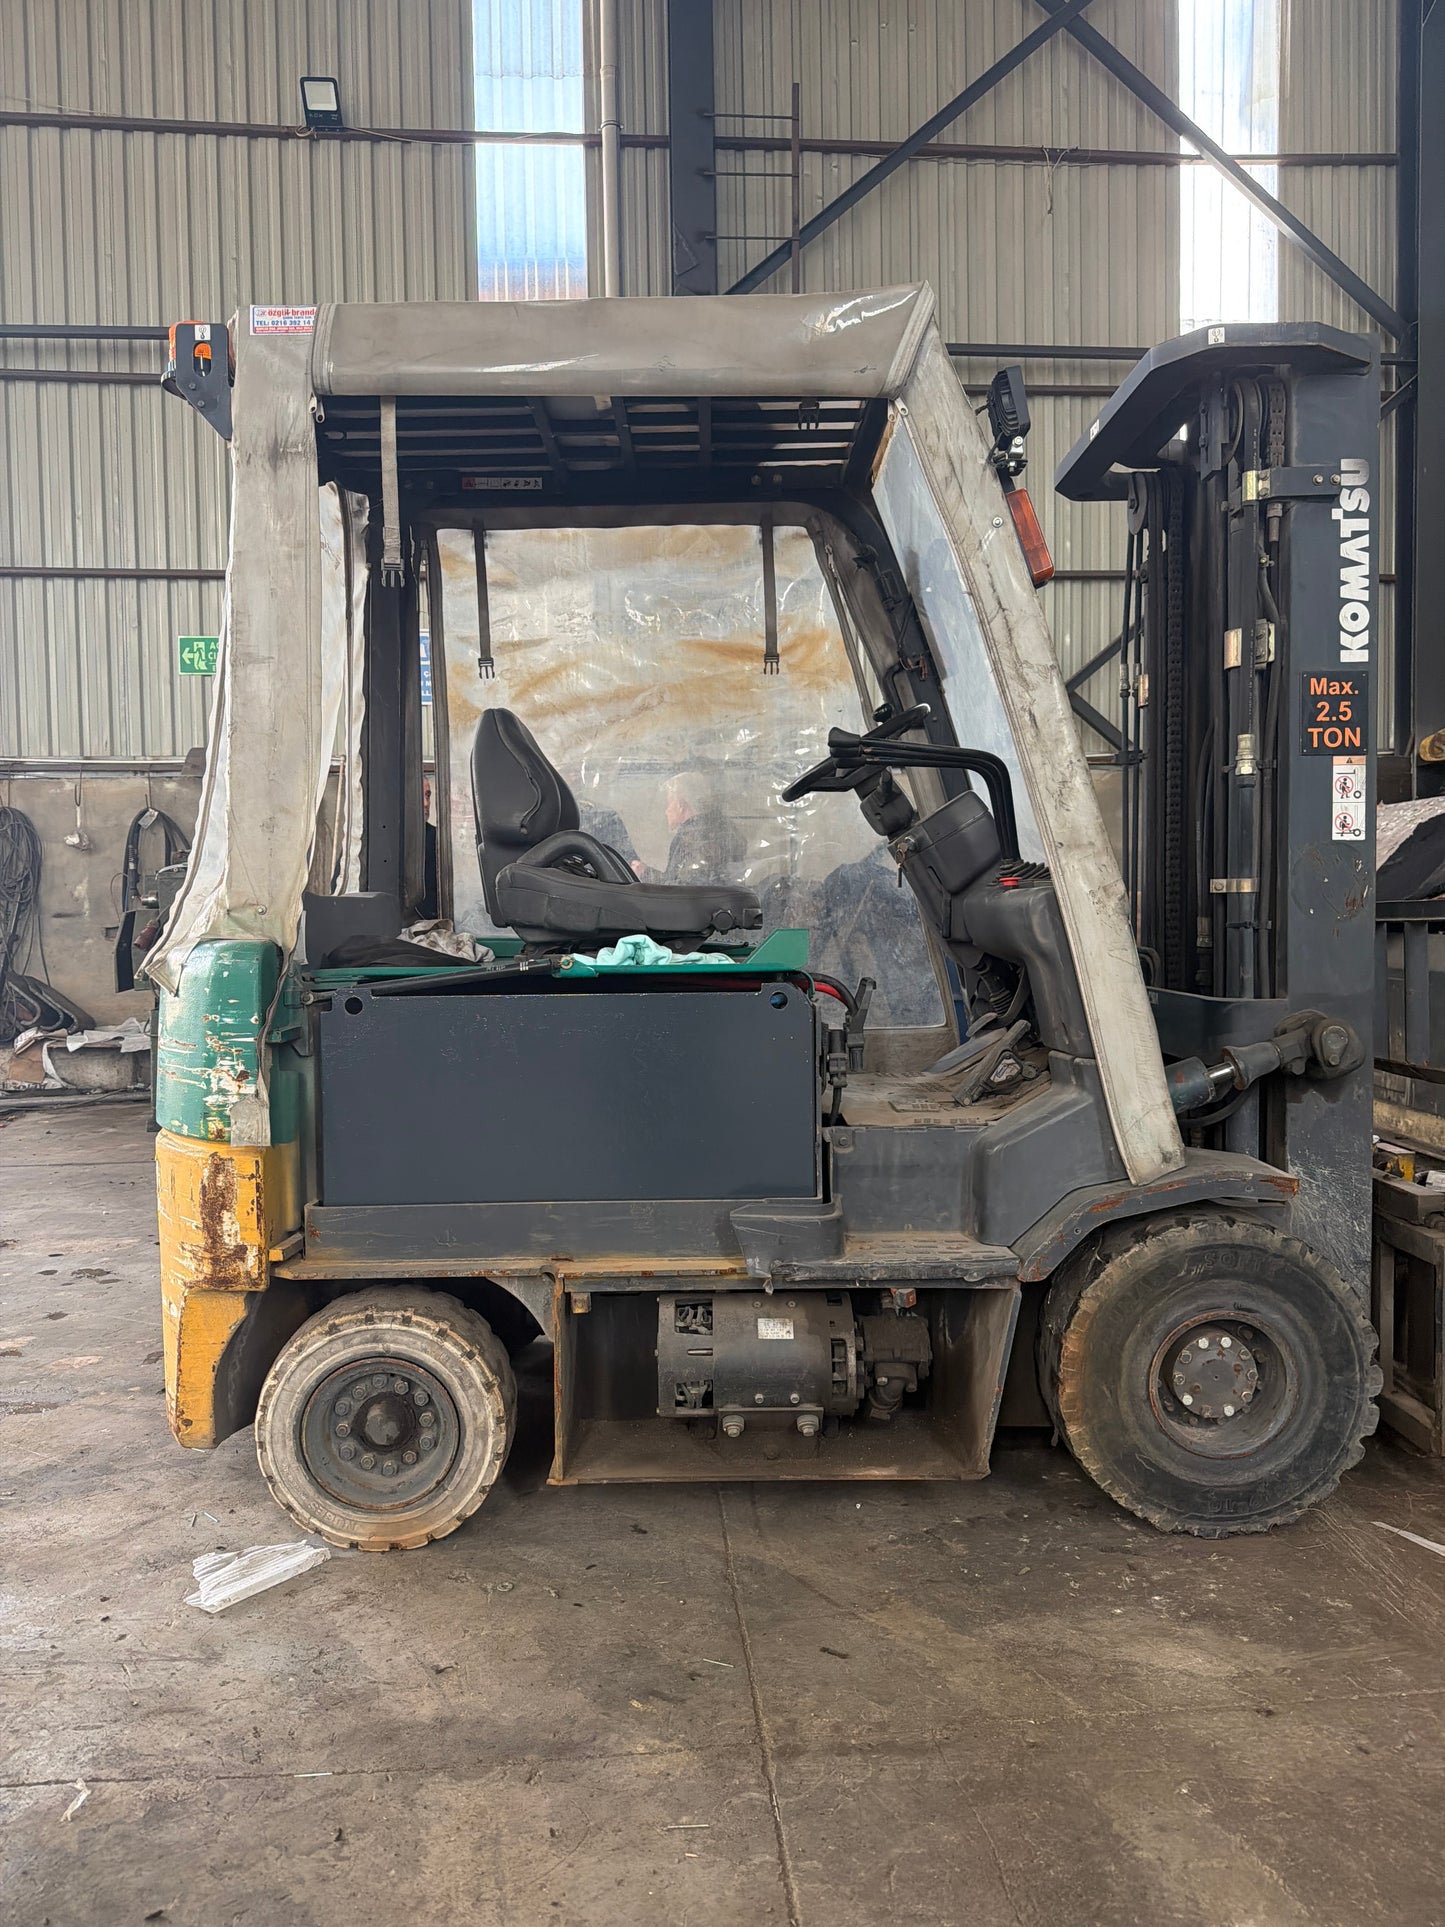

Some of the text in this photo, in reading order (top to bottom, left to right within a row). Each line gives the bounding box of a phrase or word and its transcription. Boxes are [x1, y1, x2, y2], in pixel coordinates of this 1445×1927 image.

[291, 308, 316, 316] brand
[1331, 458, 1371, 663] KOMATSU
[1309, 677, 1359, 695] Max.
[1316, 701, 1352, 721] 2.5
[1307, 727, 1361, 748] TON
